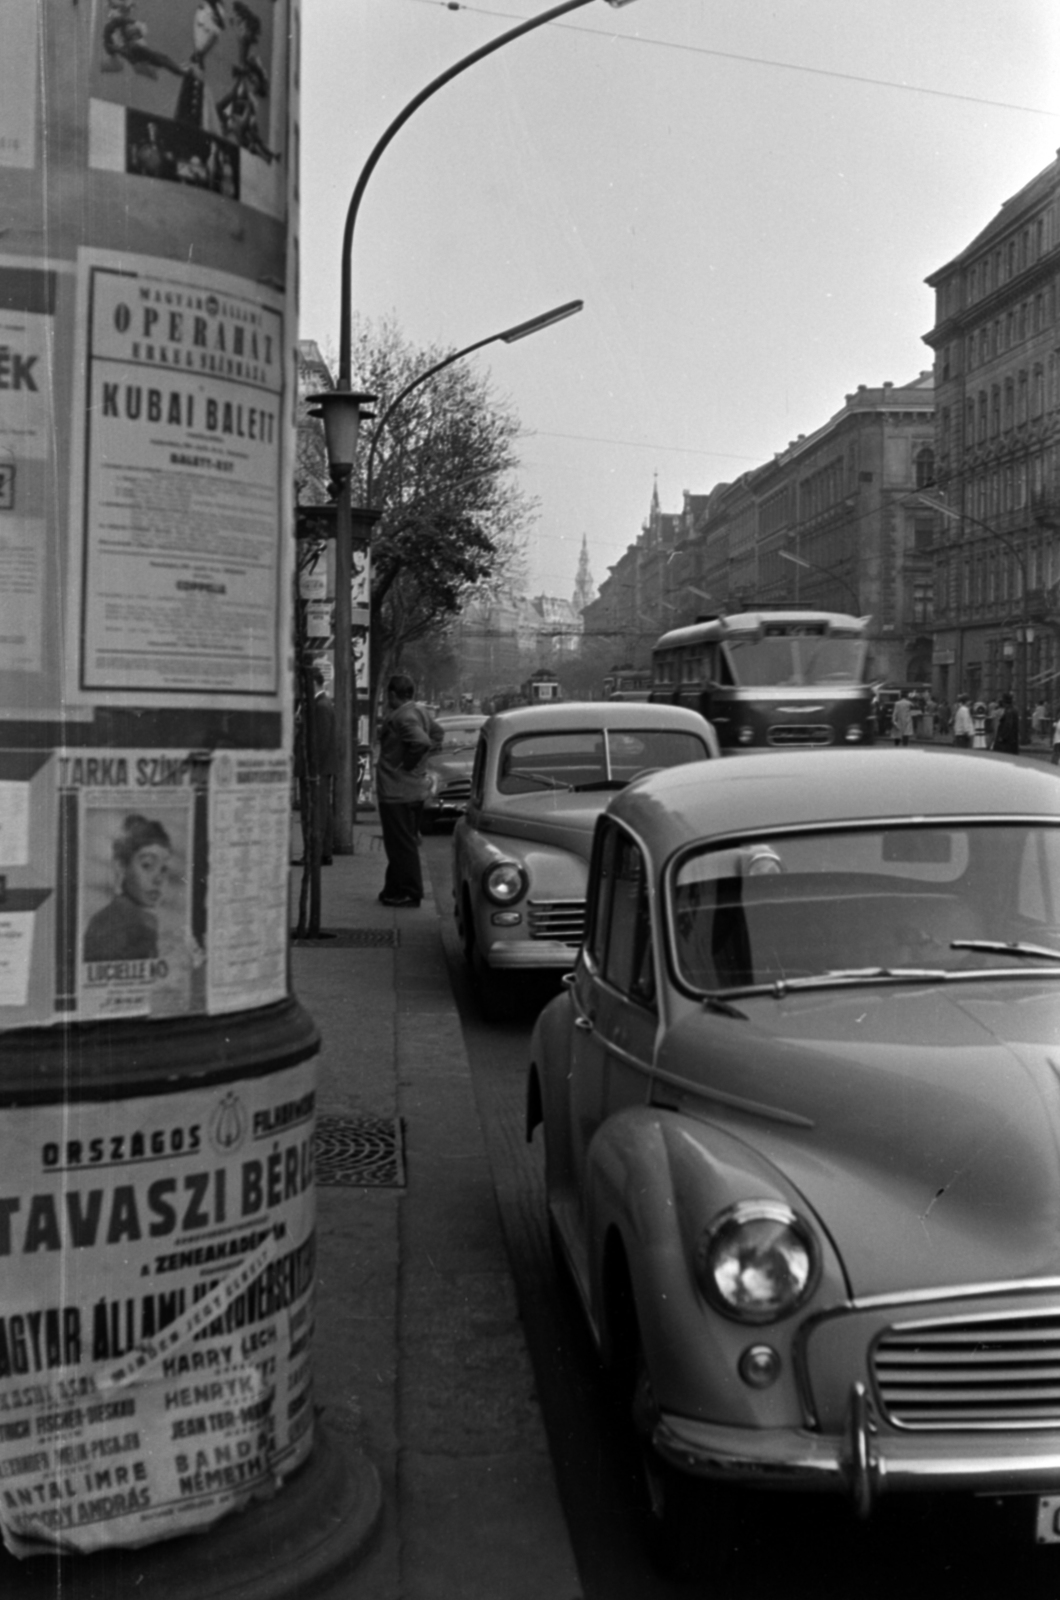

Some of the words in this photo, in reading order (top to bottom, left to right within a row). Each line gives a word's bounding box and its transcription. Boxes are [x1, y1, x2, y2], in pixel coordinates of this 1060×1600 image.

[140, 287, 203, 311] MAGYAR
[102, 381, 194, 427] KUBAI
[206, 398, 275, 444] BALETT
[58, 756, 128, 787] TARKA
[42, 1124, 201, 1166] ORSZÁGOS
[0, 1168, 227, 1256] TAVASZI
[186, 1297, 223, 1330] JEGY
[163, 1345, 233, 1378] HARRY
[165, 1376, 255, 1411] HENRYK
[171, 1414, 207, 1440] JEAN
[3, 1478, 77, 1509] ANTAL
[85, 1461, 148, 1491] IMRE
[179, 1455, 262, 1496] NÉMETH
[78, 1486, 151, 1523] ANDRÁS
